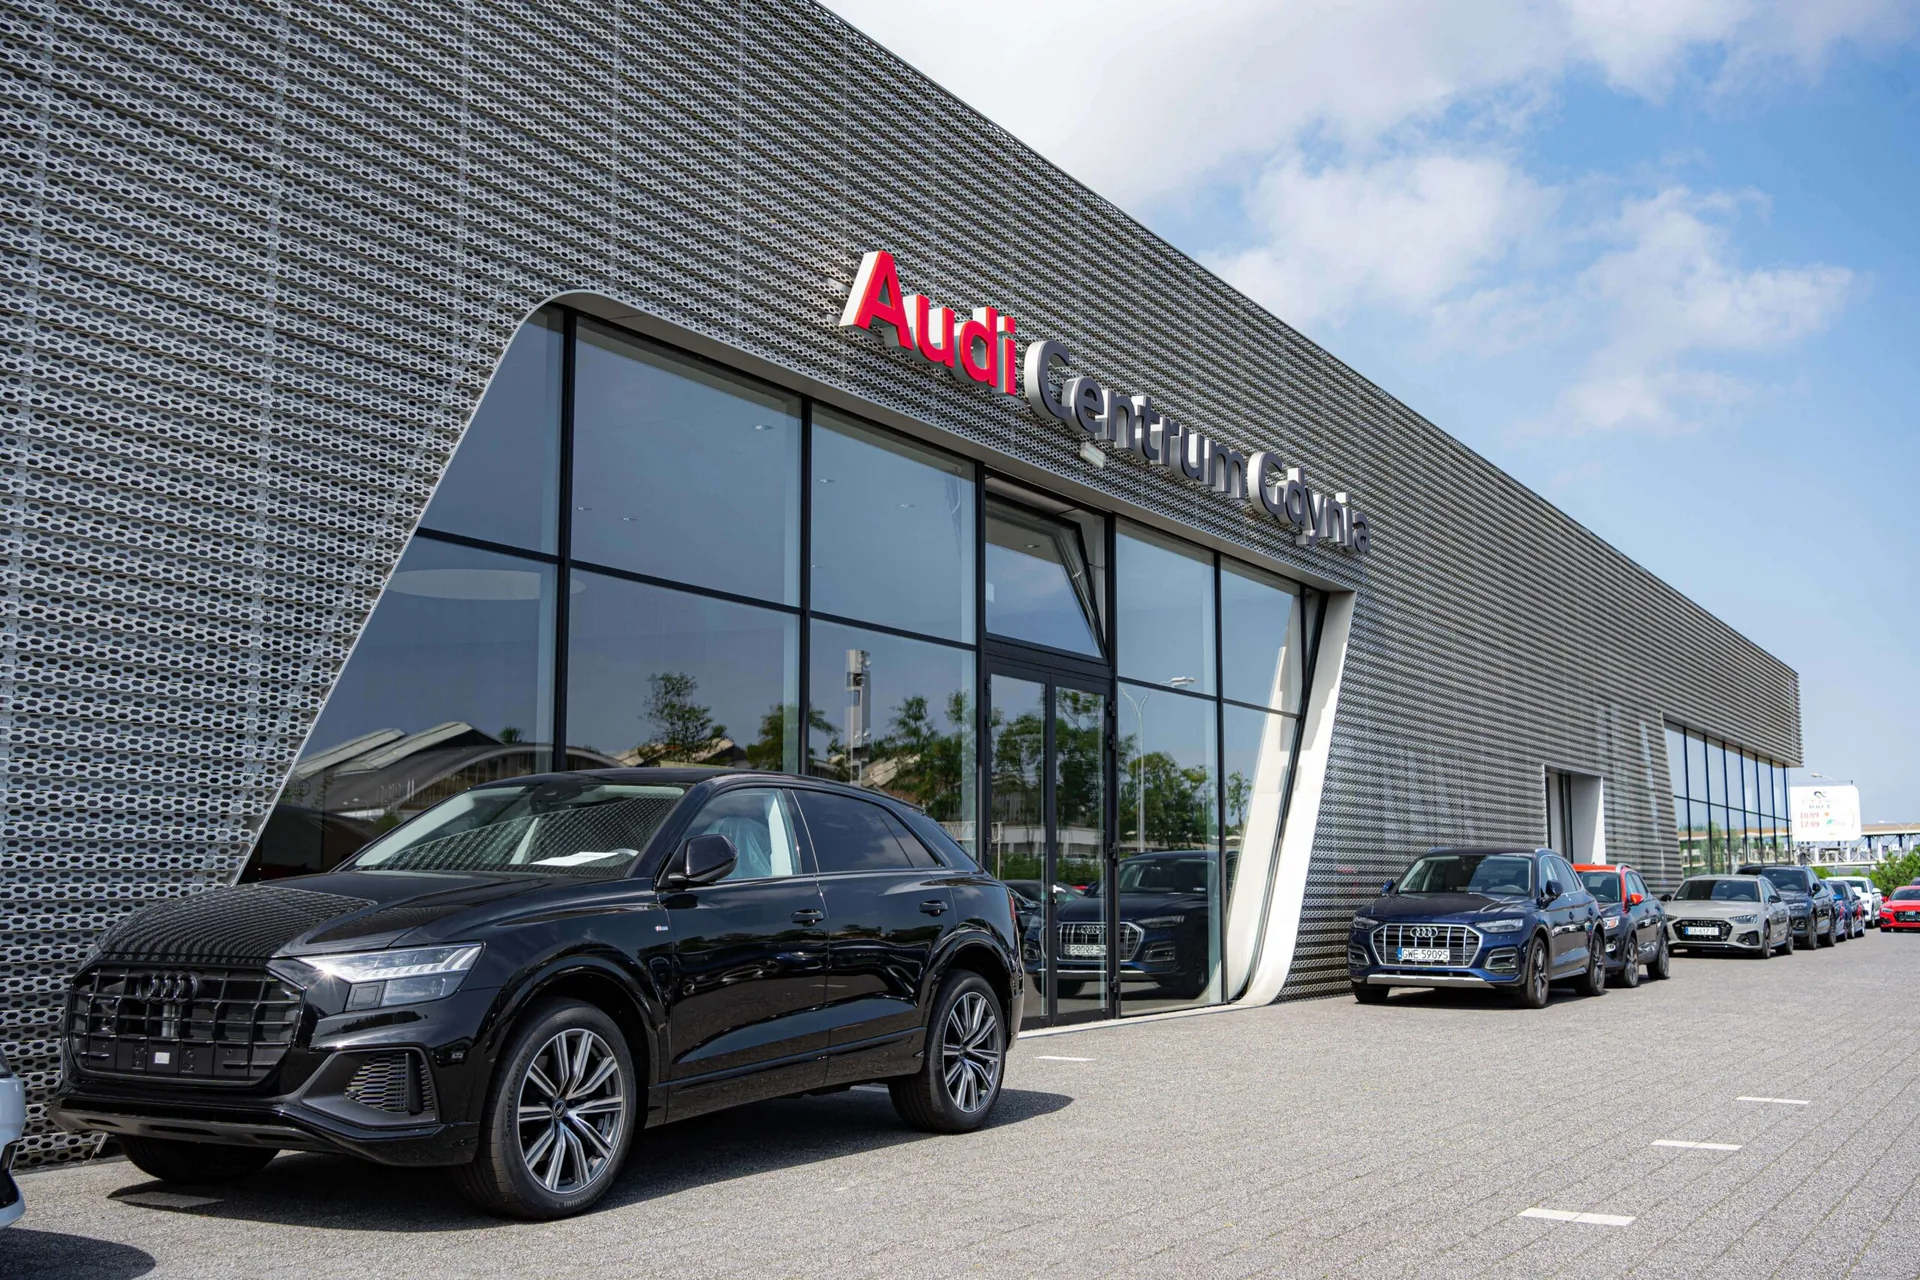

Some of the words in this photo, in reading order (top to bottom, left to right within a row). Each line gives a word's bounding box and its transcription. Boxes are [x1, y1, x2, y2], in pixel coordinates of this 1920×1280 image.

[839, 250, 1017, 397] Audi
[1023, 339, 1247, 500] Centrum
[1247, 451, 1371, 555] Gdynia
[1402, 949, 1419, 959] GWE
